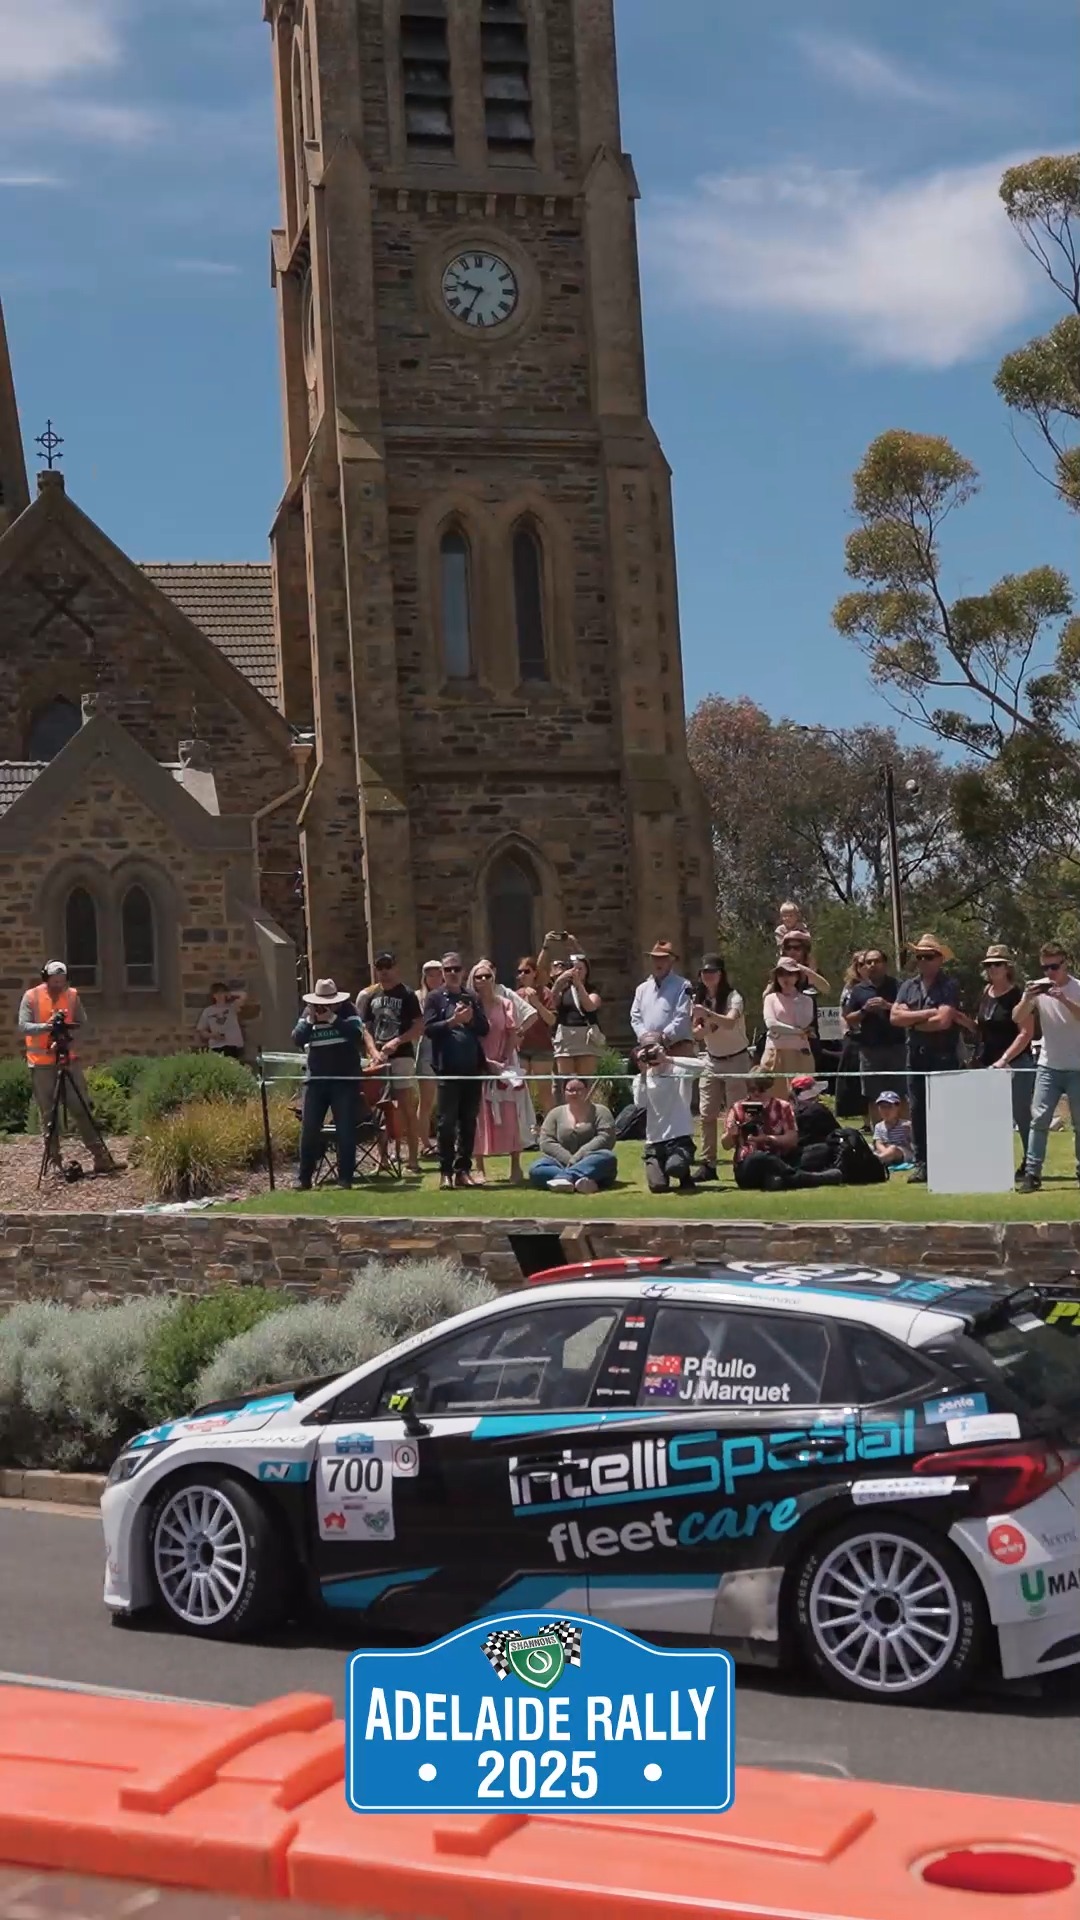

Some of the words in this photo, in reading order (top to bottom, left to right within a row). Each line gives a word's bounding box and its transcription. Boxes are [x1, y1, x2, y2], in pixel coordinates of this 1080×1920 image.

[683, 1357, 757, 1379] P.Rullo
[679, 1380, 791, 1405] J.Marquet
[326, 1457, 384, 1493] 700
